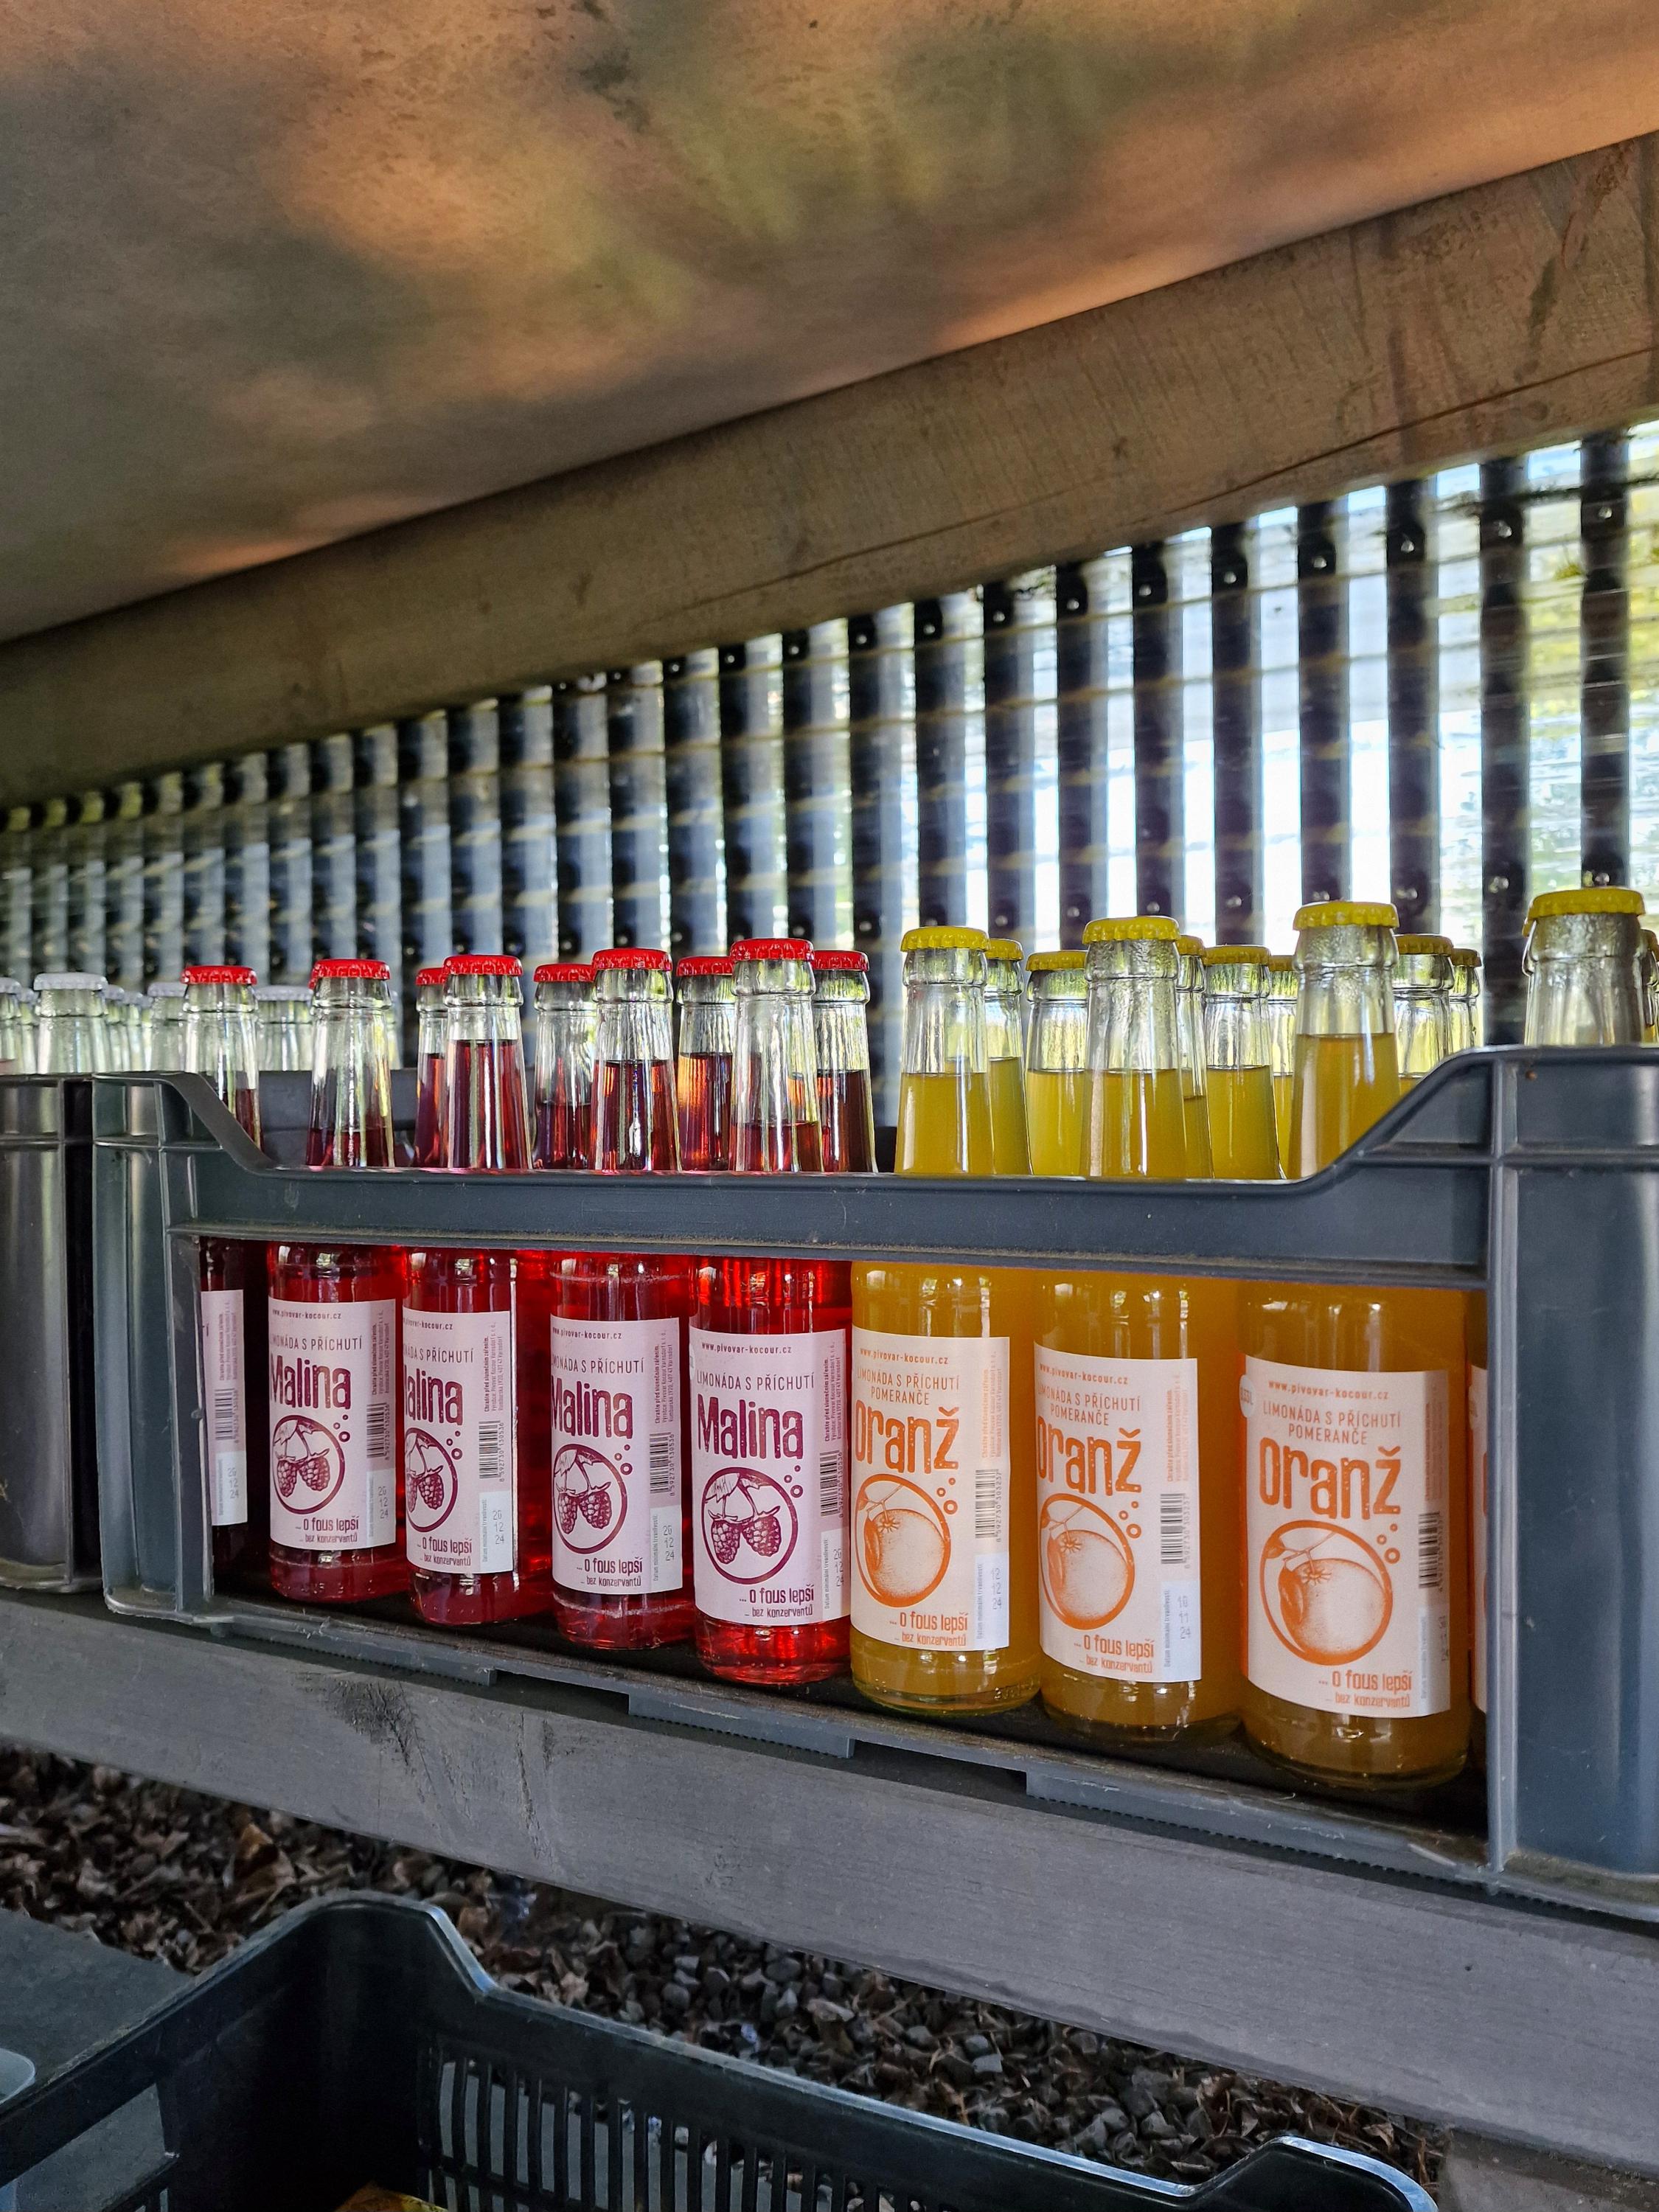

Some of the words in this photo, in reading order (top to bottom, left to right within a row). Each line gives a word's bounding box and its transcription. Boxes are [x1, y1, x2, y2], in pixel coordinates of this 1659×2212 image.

[302, 1338, 307, 1351] S
[311, 1335, 363, 1351] PŘÍCHUTÍ
[701, 1342, 792, 1354] www.pivovar-kocour.cz
[420, 1348, 424, 1360] S
[427, 1347, 473, 1363] PŘÍCHUTÍ
[582, 1360, 587, 1373] S
[591, 1357, 644, 1374] PŘÍCHUTÍ
[271, 1353, 351, 1410] Malina
[697, 1370, 741, 1390] LIMONÁDA
[745, 1378, 751, 1391] S
[757, 1372, 815, 1391] PŘÍCHUTÍ
[857, 1366, 893, 1385] LIMONÁDA
[897, 1375, 902, 1387] S
[906, 1373, 959, 1391] PŘÍCHUTÍ
[871, 1385, 930, 1405] POMERANČE
[1267, 1380, 1389, 1400] www.pivovar-kocour.cz
[551, 1375, 633, 1439] Malina
[1075, 1392, 1080, 1406] S
[1085, 1392, 1141, 1411] PŘÍCHUTÍ
[1050, 1403, 1110, 1427] POMERANČE
[1262, 1401, 1321, 1425] LIMONÁDA
[1325, 1411, 1332, 1425] S
[1338, 1411, 1402, 1428] PŘÍCHUTÍ
[698, 1393, 804, 1459] Malina
[855, 1399, 959, 1474] Oranž
[1288, 1423, 1368, 1445] POMERANČE
[1037, 1416, 1141, 1496] Oranž
[1259, 1437, 1401, 1520] Oranž
[312, 1517, 333, 1531] fous
[336, 1515, 359, 1533] lepší
[429, 1537, 448, 1552] fous
[451, 1538, 472, 1556] lepší
[495, 1534, 504, 1545] 24
[665, 1550, 675, 1561] 24
[593, 1558, 616, 1573] fous
[619, 1557, 643, 1576] lepší
[759, 1587, 786, 1604] fous
[790, 1584, 815, 1605] lepší
[752, 1607, 764, 1617] bez
[910, 1611, 937, 1630] fous
[941, 1612, 968, 1634] lepší
[902, 1631, 914, 1643] bez
[1094, 1634, 1121, 1655] fous
[1126, 1638, 1155, 1660] lepší
[1345, 1669, 1378, 1691] fous
[1382, 1670, 1413, 1695] lepší
